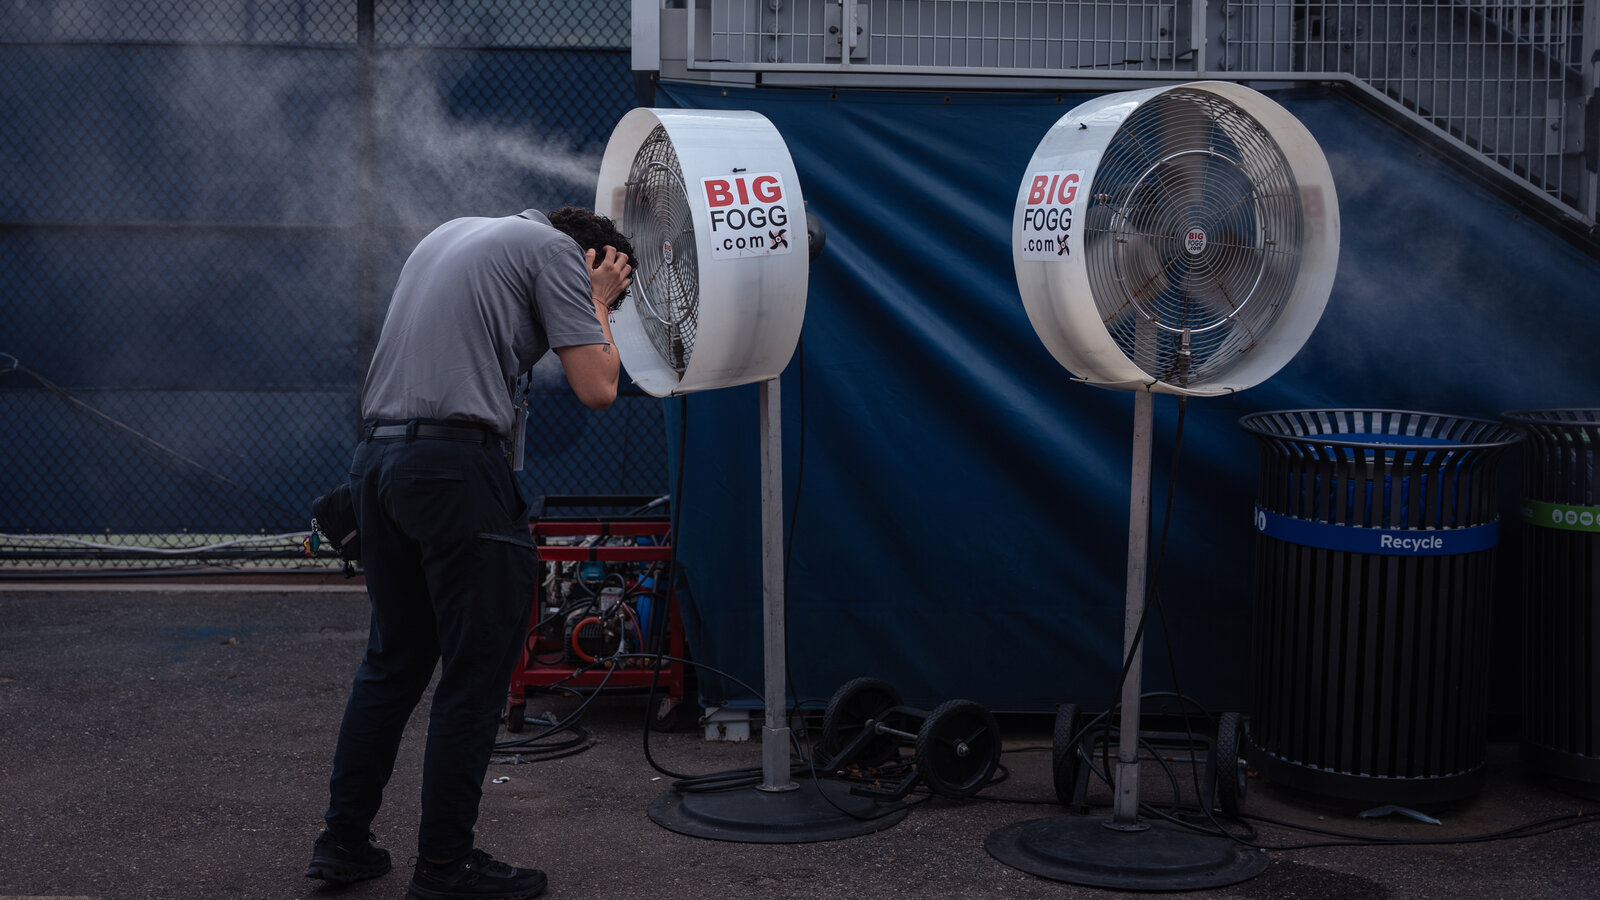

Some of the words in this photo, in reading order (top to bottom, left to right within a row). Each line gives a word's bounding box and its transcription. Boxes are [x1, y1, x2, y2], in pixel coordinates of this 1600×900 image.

[703, 175, 783, 208] BIG
[1027, 173, 1080, 205] BIG
[710, 205, 788, 232] FOGG
[1023, 208, 1072, 231] FOGG
[716, 235, 764, 251] .com
[1023, 239, 1054, 252] .com
[1188, 232, 1204, 240] BIG
[1380, 534, 1443, 552] Recycle
